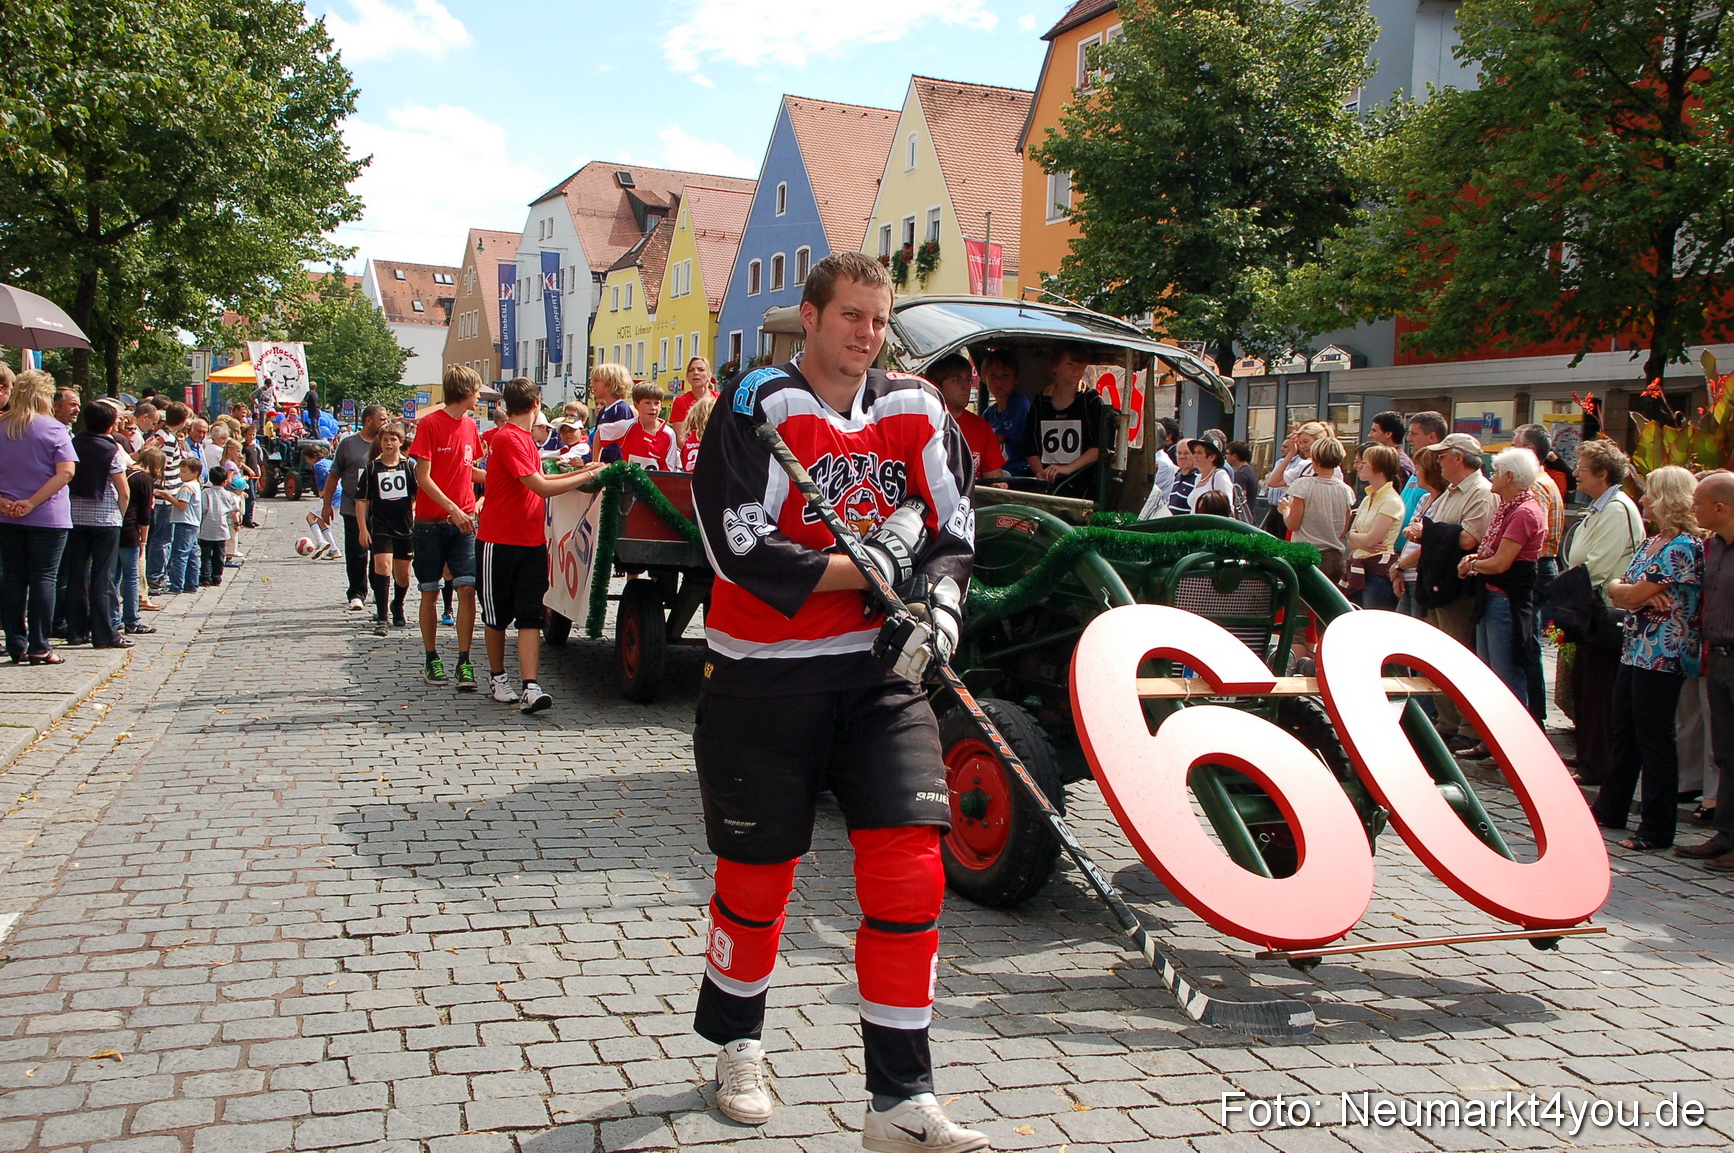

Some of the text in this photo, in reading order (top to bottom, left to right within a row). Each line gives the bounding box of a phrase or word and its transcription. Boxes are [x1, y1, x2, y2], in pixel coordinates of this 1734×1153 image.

[551, 294, 561, 333] RUPPERT
[617, 325, 632, 339] HOTEL
[1187, 398, 1193, 407] 6
[1042, 427, 1080, 454] 60
[380, 475, 406, 492] 60
[808, 451, 907, 507] Eagles
[722, 502, 778, 556] 69
[1069, 603, 1611, 951] 60
